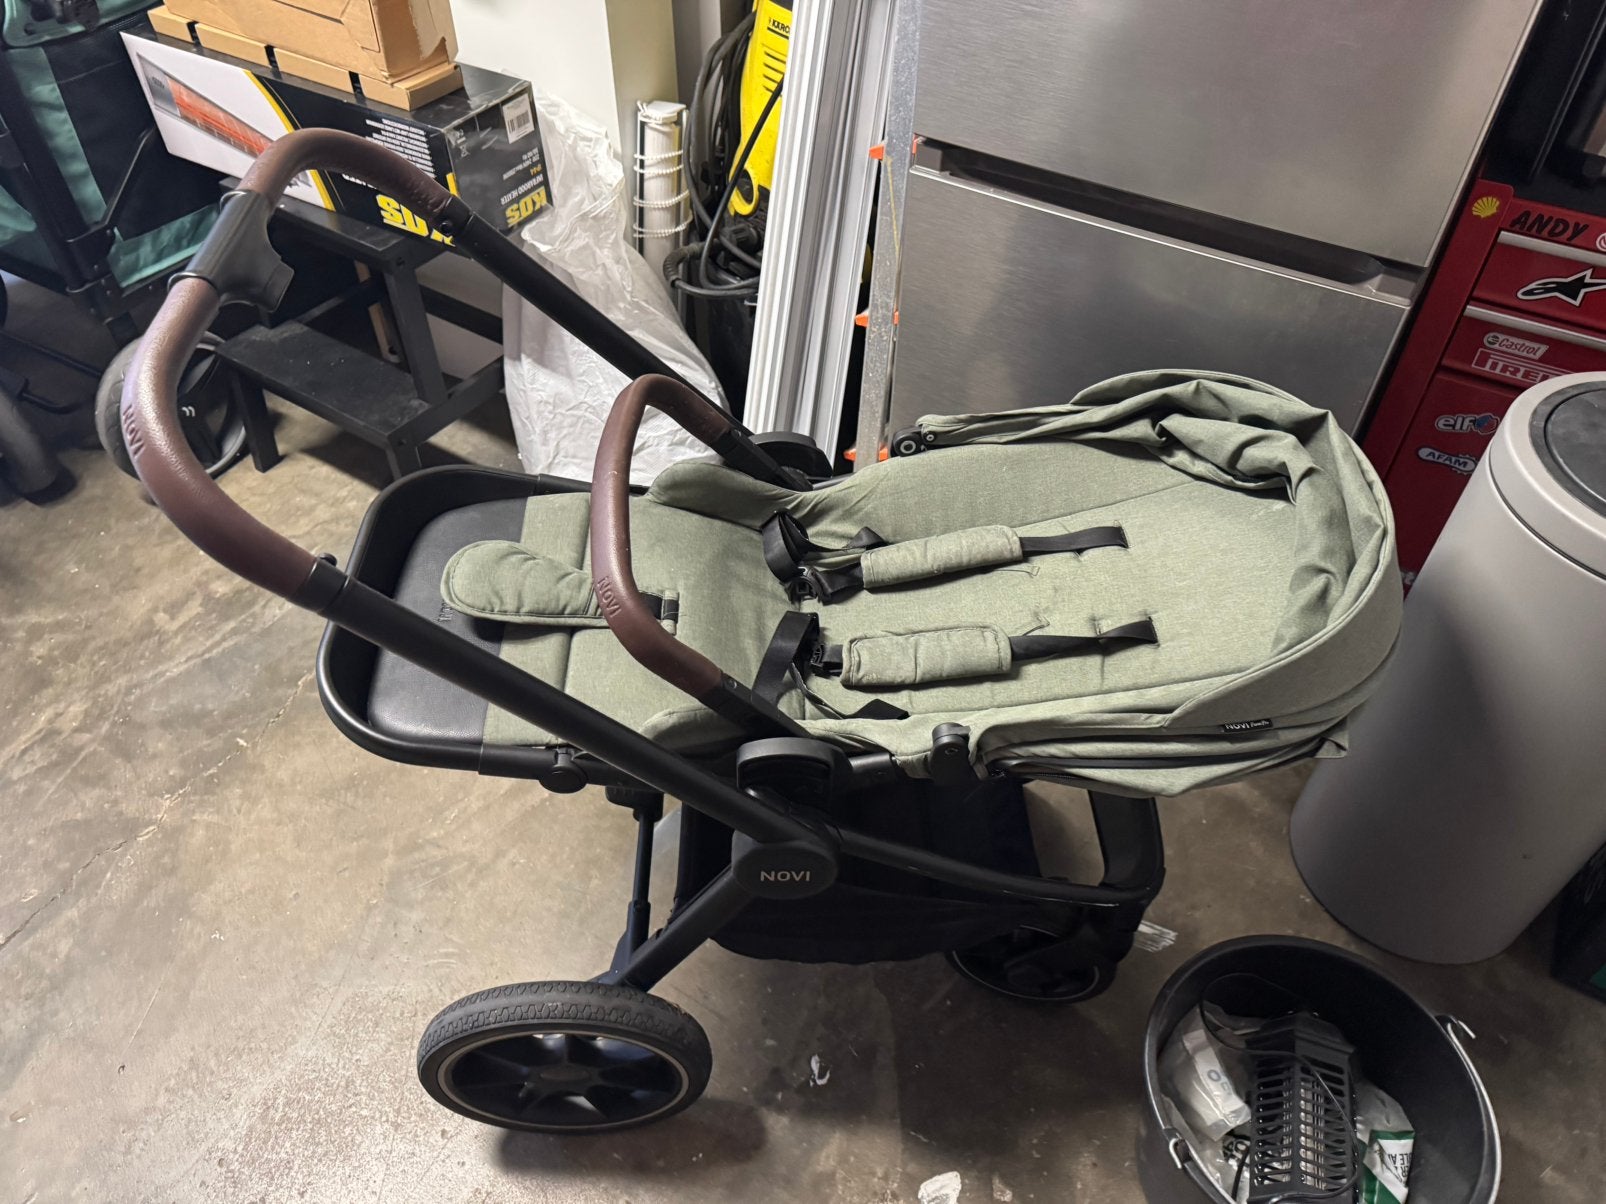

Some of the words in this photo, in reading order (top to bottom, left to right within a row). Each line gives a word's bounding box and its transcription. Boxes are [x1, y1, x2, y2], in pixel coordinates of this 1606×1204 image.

[501, 188, 518, 205] HEATER
[505, 186, 548, 228] KOS
[1509, 210, 1589, 241] ANDY
[1498, 337, 1541, 356] Castrol
[123, 404, 145, 457] NOVI
[1438, 415, 1477, 431] elf
[1425, 451, 1469, 469] AFAM
[597, 576, 622, 618] NOVI
[760, 870, 811, 881] NOVI
